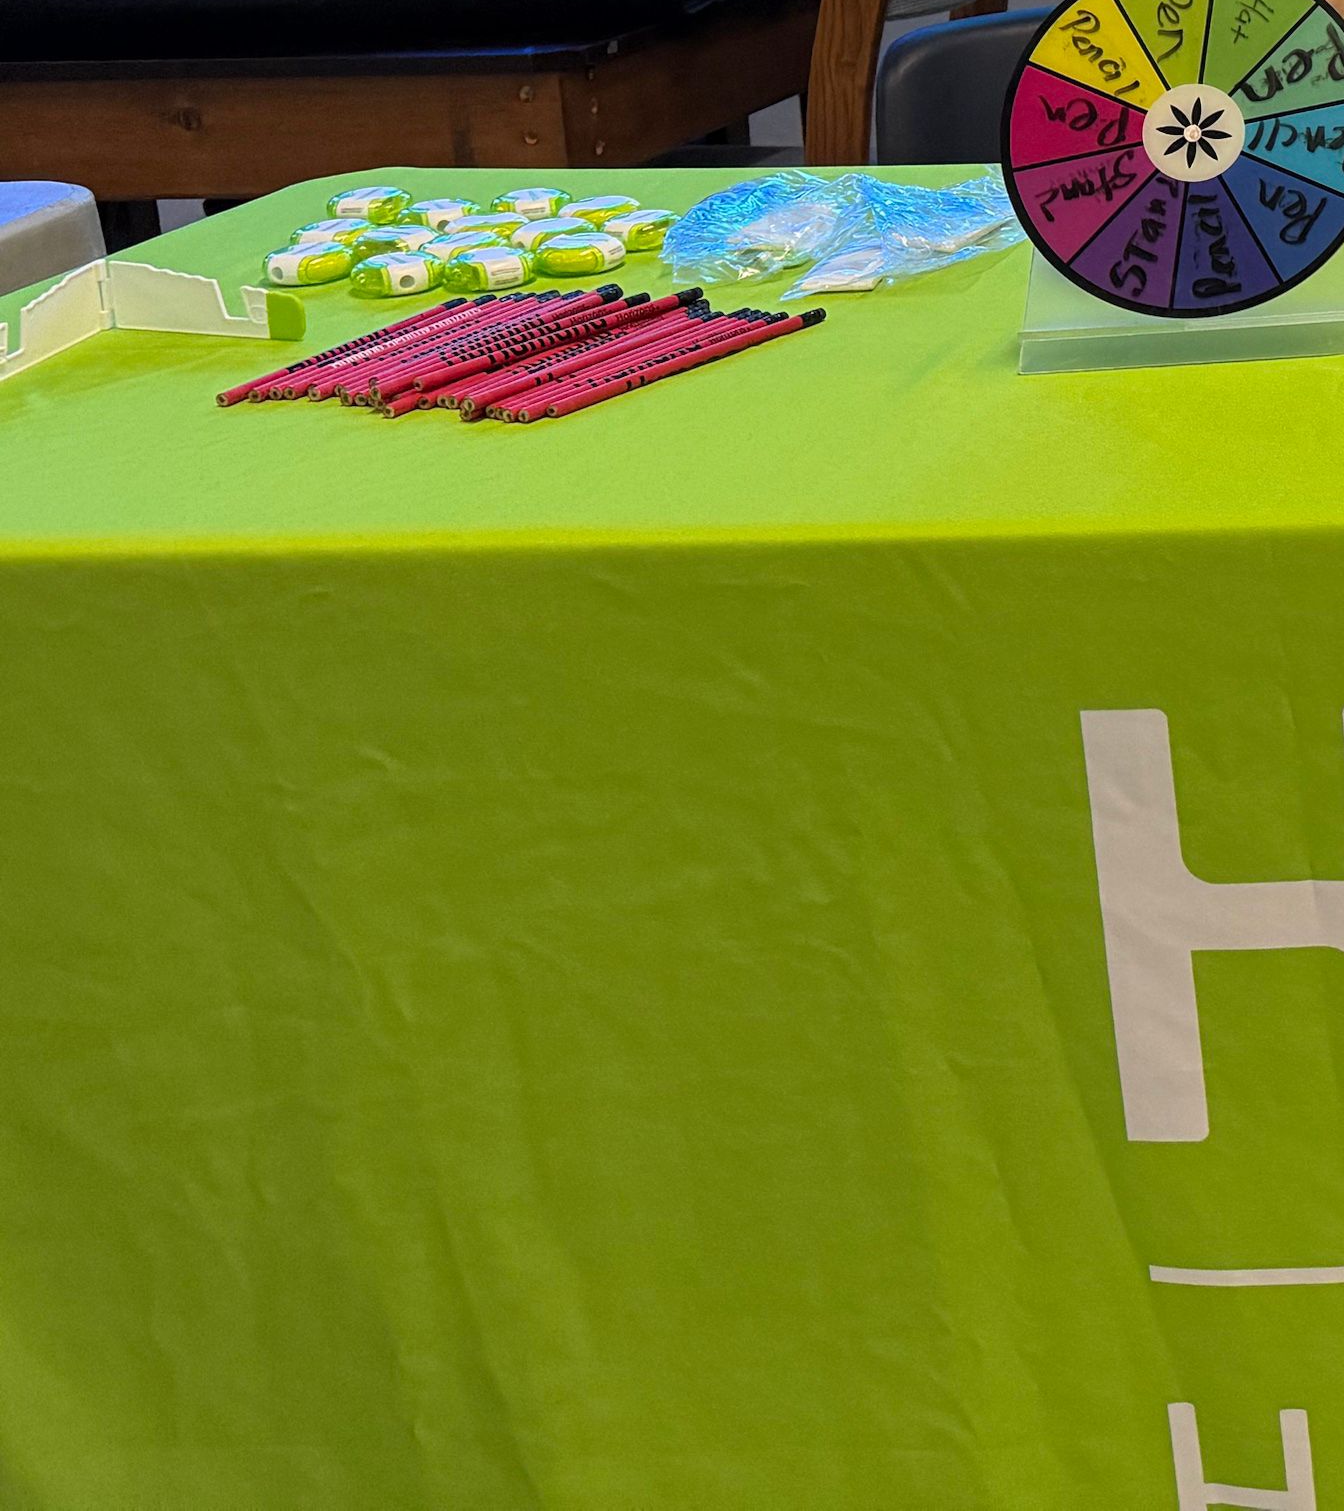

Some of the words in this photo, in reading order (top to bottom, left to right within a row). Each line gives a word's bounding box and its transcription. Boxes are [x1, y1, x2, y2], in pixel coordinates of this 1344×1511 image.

[1059, 9, 1141, 98] Pencil
[1039, 96, 1130, 147] Pen
[1258, 178, 1328, 245] Pen
